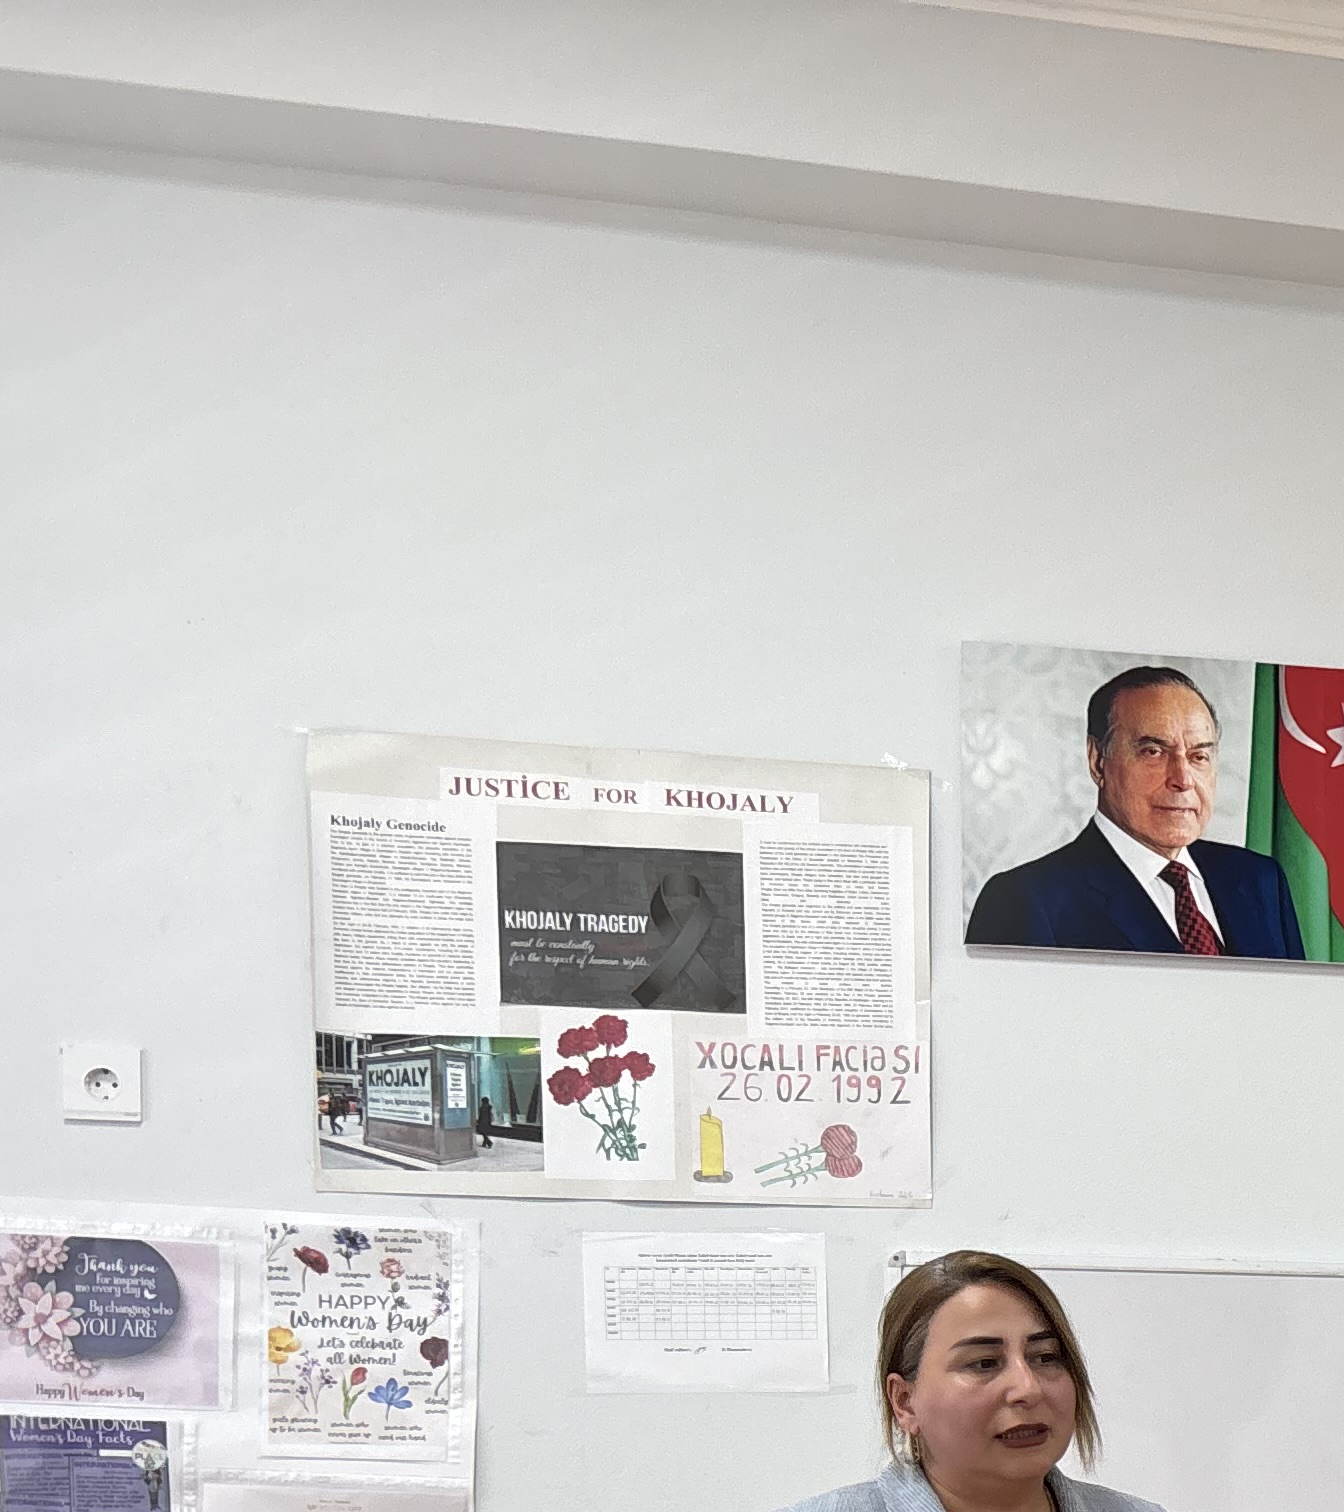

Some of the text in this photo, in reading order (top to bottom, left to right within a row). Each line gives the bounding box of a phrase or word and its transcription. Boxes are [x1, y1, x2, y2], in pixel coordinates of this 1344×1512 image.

[449, 775, 794, 814] JUSTİCE FOR KHOJALY
[330, 814, 446, 832] Khojaly Genocide
[504, 910, 648, 933] KHOJALY TRAGEDY
[696, 1042, 803, 1071] XOCALI
[369, 1067, 428, 1087] KHOJALY
[76, 1253, 159, 1276] Thank you
[92, 1286, 121, 1297] every
[123, 1285, 140, 1298] day
[114, 1276, 156, 1289] inspiring
[89, 1300, 173, 1318] By changing who
[318, 1294, 390, 1310] HAPPY
[80, 1317, 156, 1338] YOU ARE
[290, 1310, 433, 1336] Women's Day
[350, 1336, 404, 1350] celebrate
[326, 1352, 345, 1365] all
[36, 1383, 65, 1399] Happy
[127, 1386, 144, 1401] Day
[67, 1430, 93, 1448] Day
[96, 1431, 133, 1445] Facts
